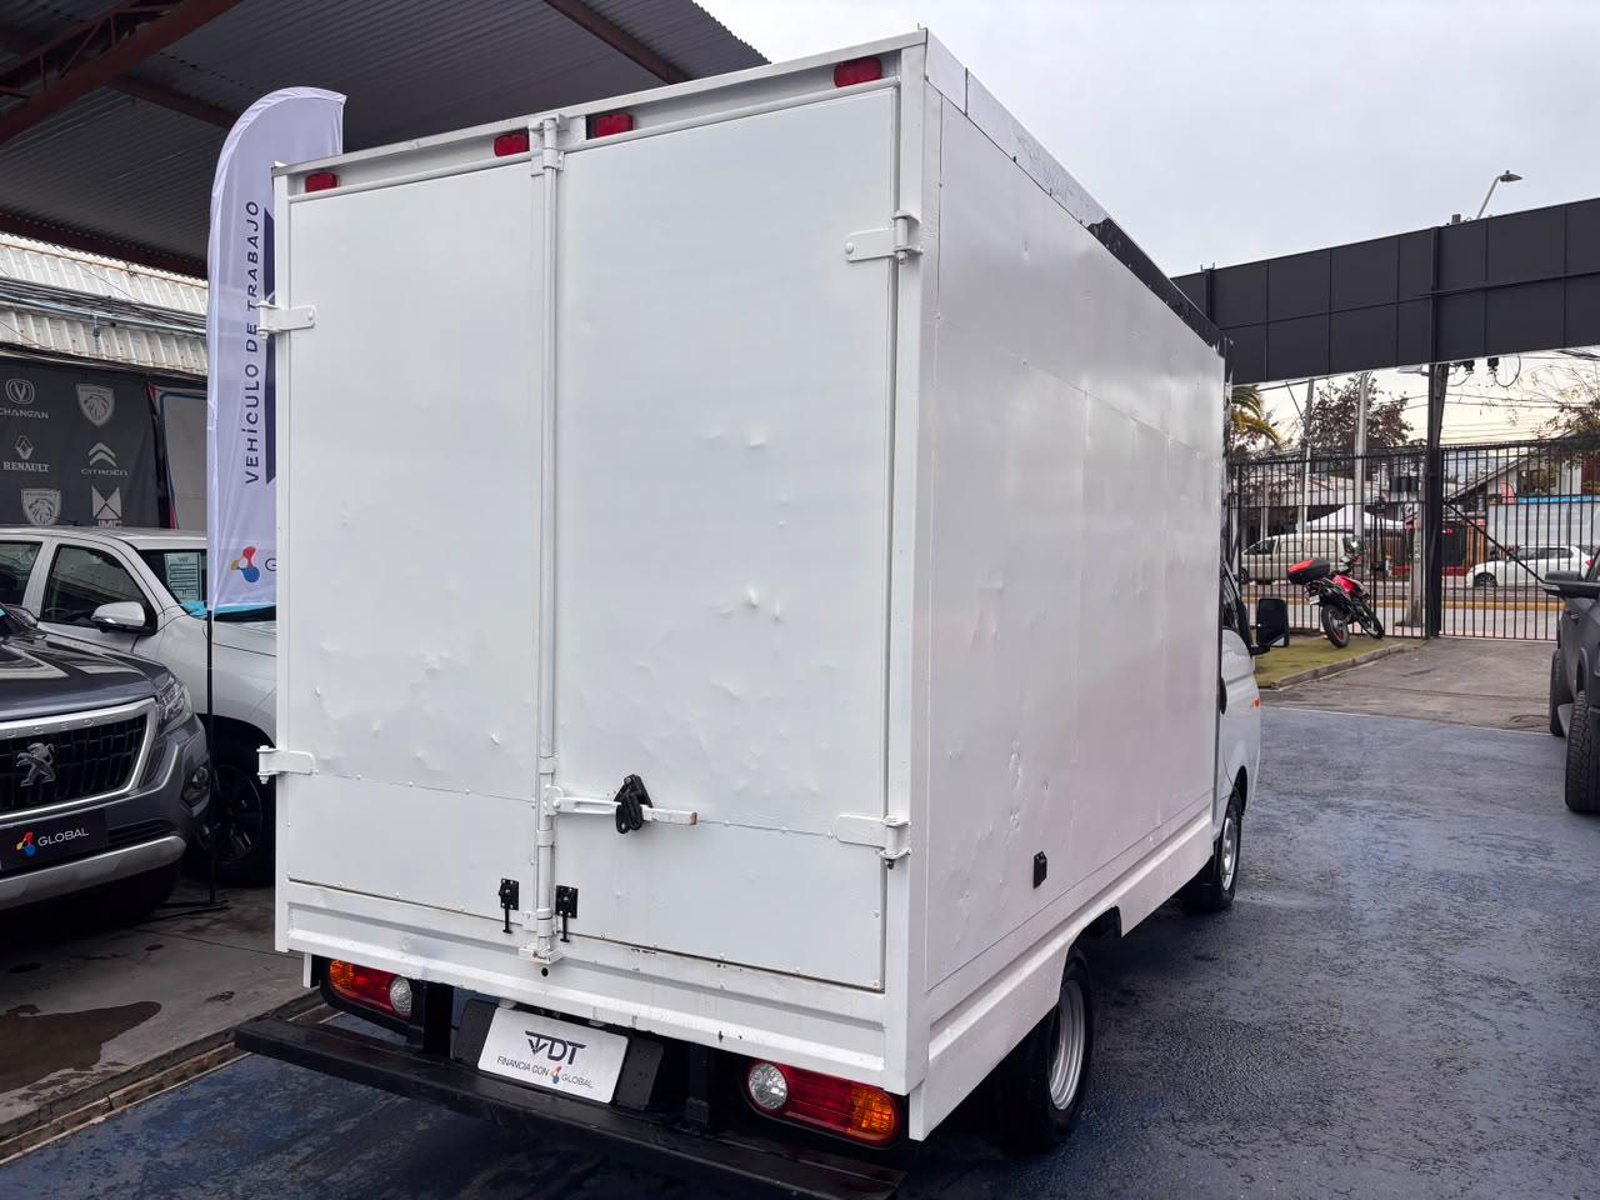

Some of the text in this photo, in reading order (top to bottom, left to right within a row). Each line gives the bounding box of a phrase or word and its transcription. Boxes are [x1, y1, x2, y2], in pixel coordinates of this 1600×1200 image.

[245, 200, 259, 312] TRABAJO
[245, 322, 258, 353] DE
[3, 461, 50, 472] RENAULT
[37, 827, 90, 847] GLOBAL
[497, 1056, 593, 1089] FINANCIA CON GLOBAL
